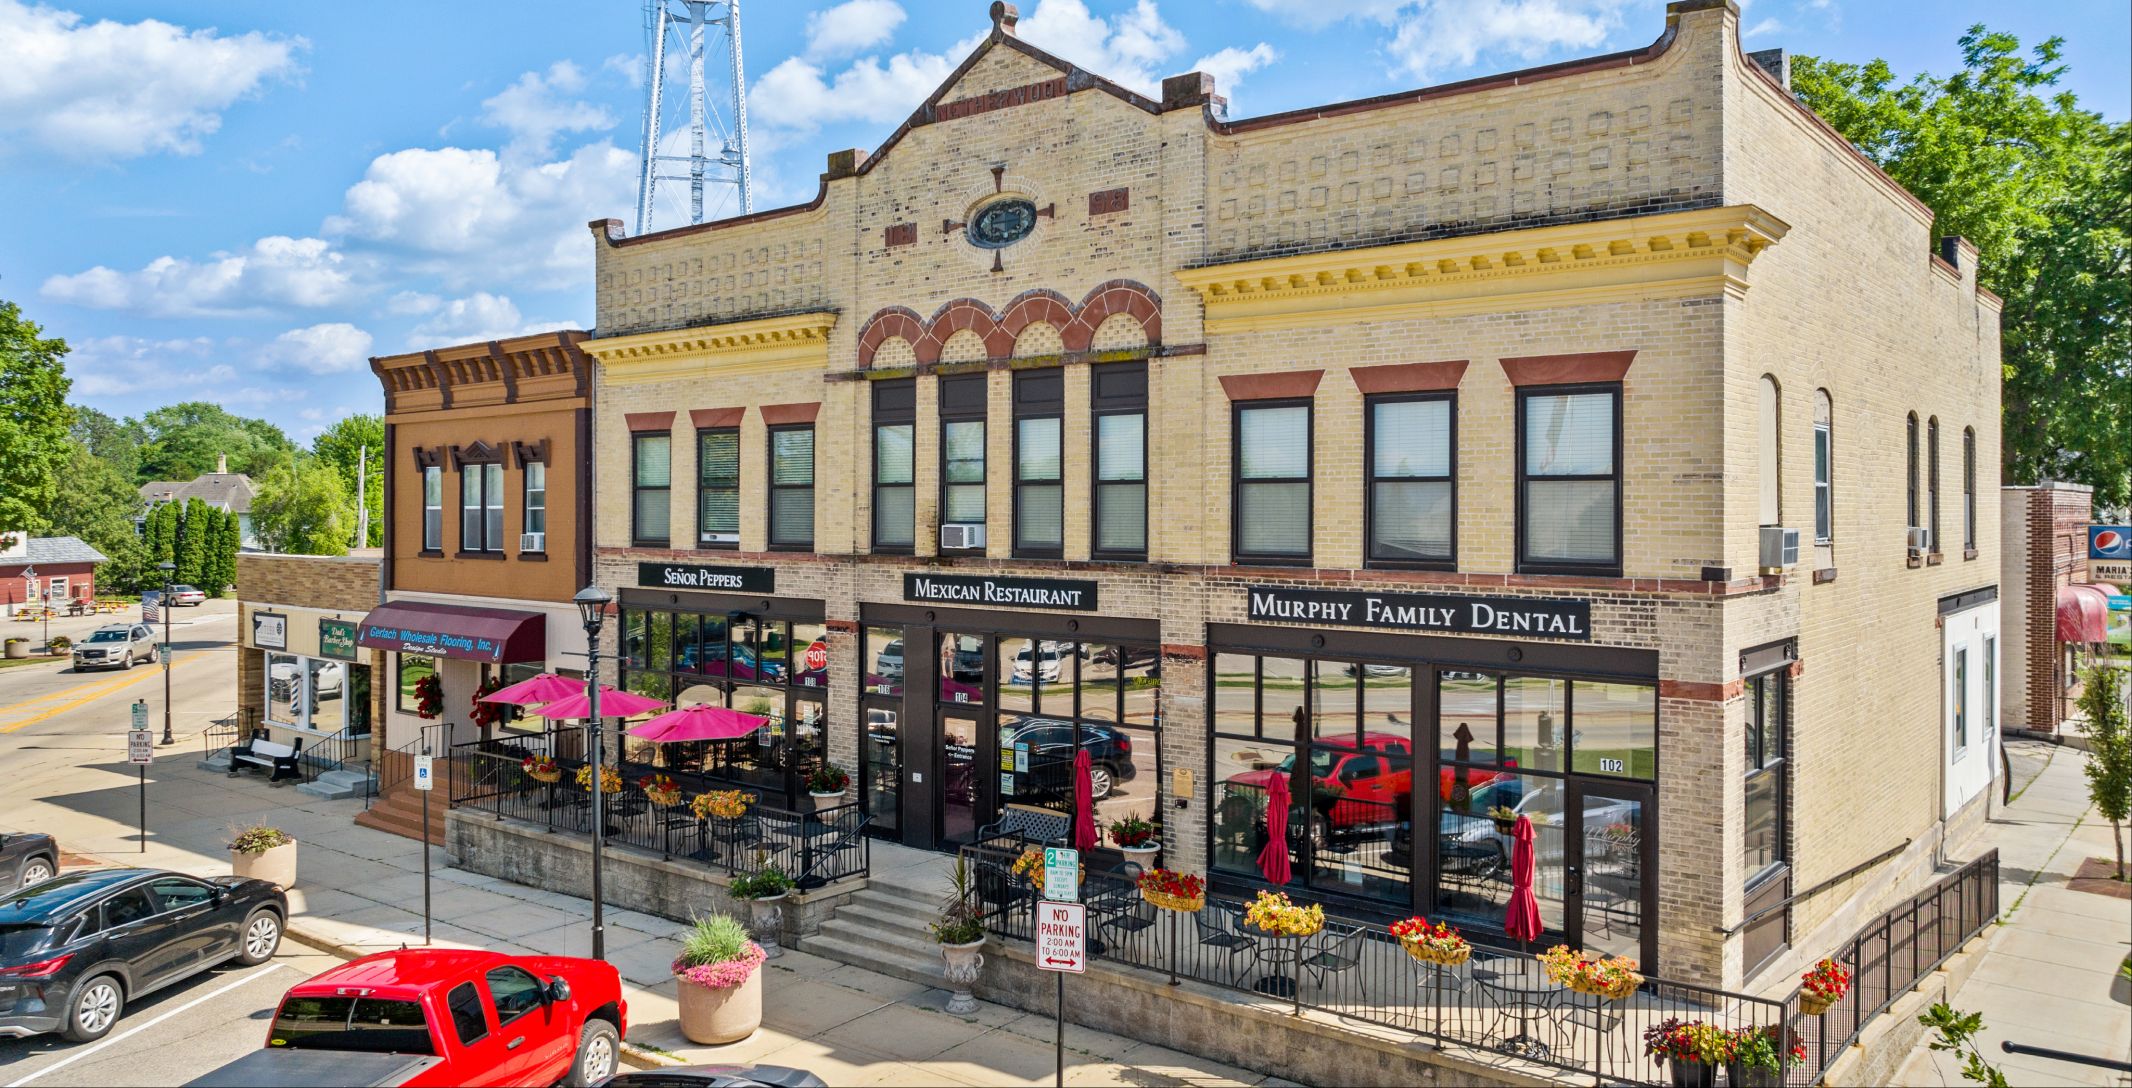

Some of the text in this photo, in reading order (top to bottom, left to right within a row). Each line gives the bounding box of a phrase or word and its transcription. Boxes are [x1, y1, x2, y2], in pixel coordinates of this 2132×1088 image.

[664, 567, 742, 588] SEÑOR PEPPERS
[915, 578, 1081, 606] MEXICAN RESTAURANT
[1252, 593, 1583, 634] MURPHY FAMILY DENTAL
[369, 626, 492, 651] Gerlach Wholesale Flooring, Inc.
[403, 642, 448, 656] Design Studio
[1601, 758, 1622, 772] 102
[1583, 825, 1641, 849] Murphy
[1047, 851, 1055, 865] 2
[1052, 909, 1068, 922] NO
[1041, 923, 1080, 939] PARKING
[1047, 938, 1075, 948] 2:00 AM
[1041, 947, 1080, 959] TO 6:00 AM
